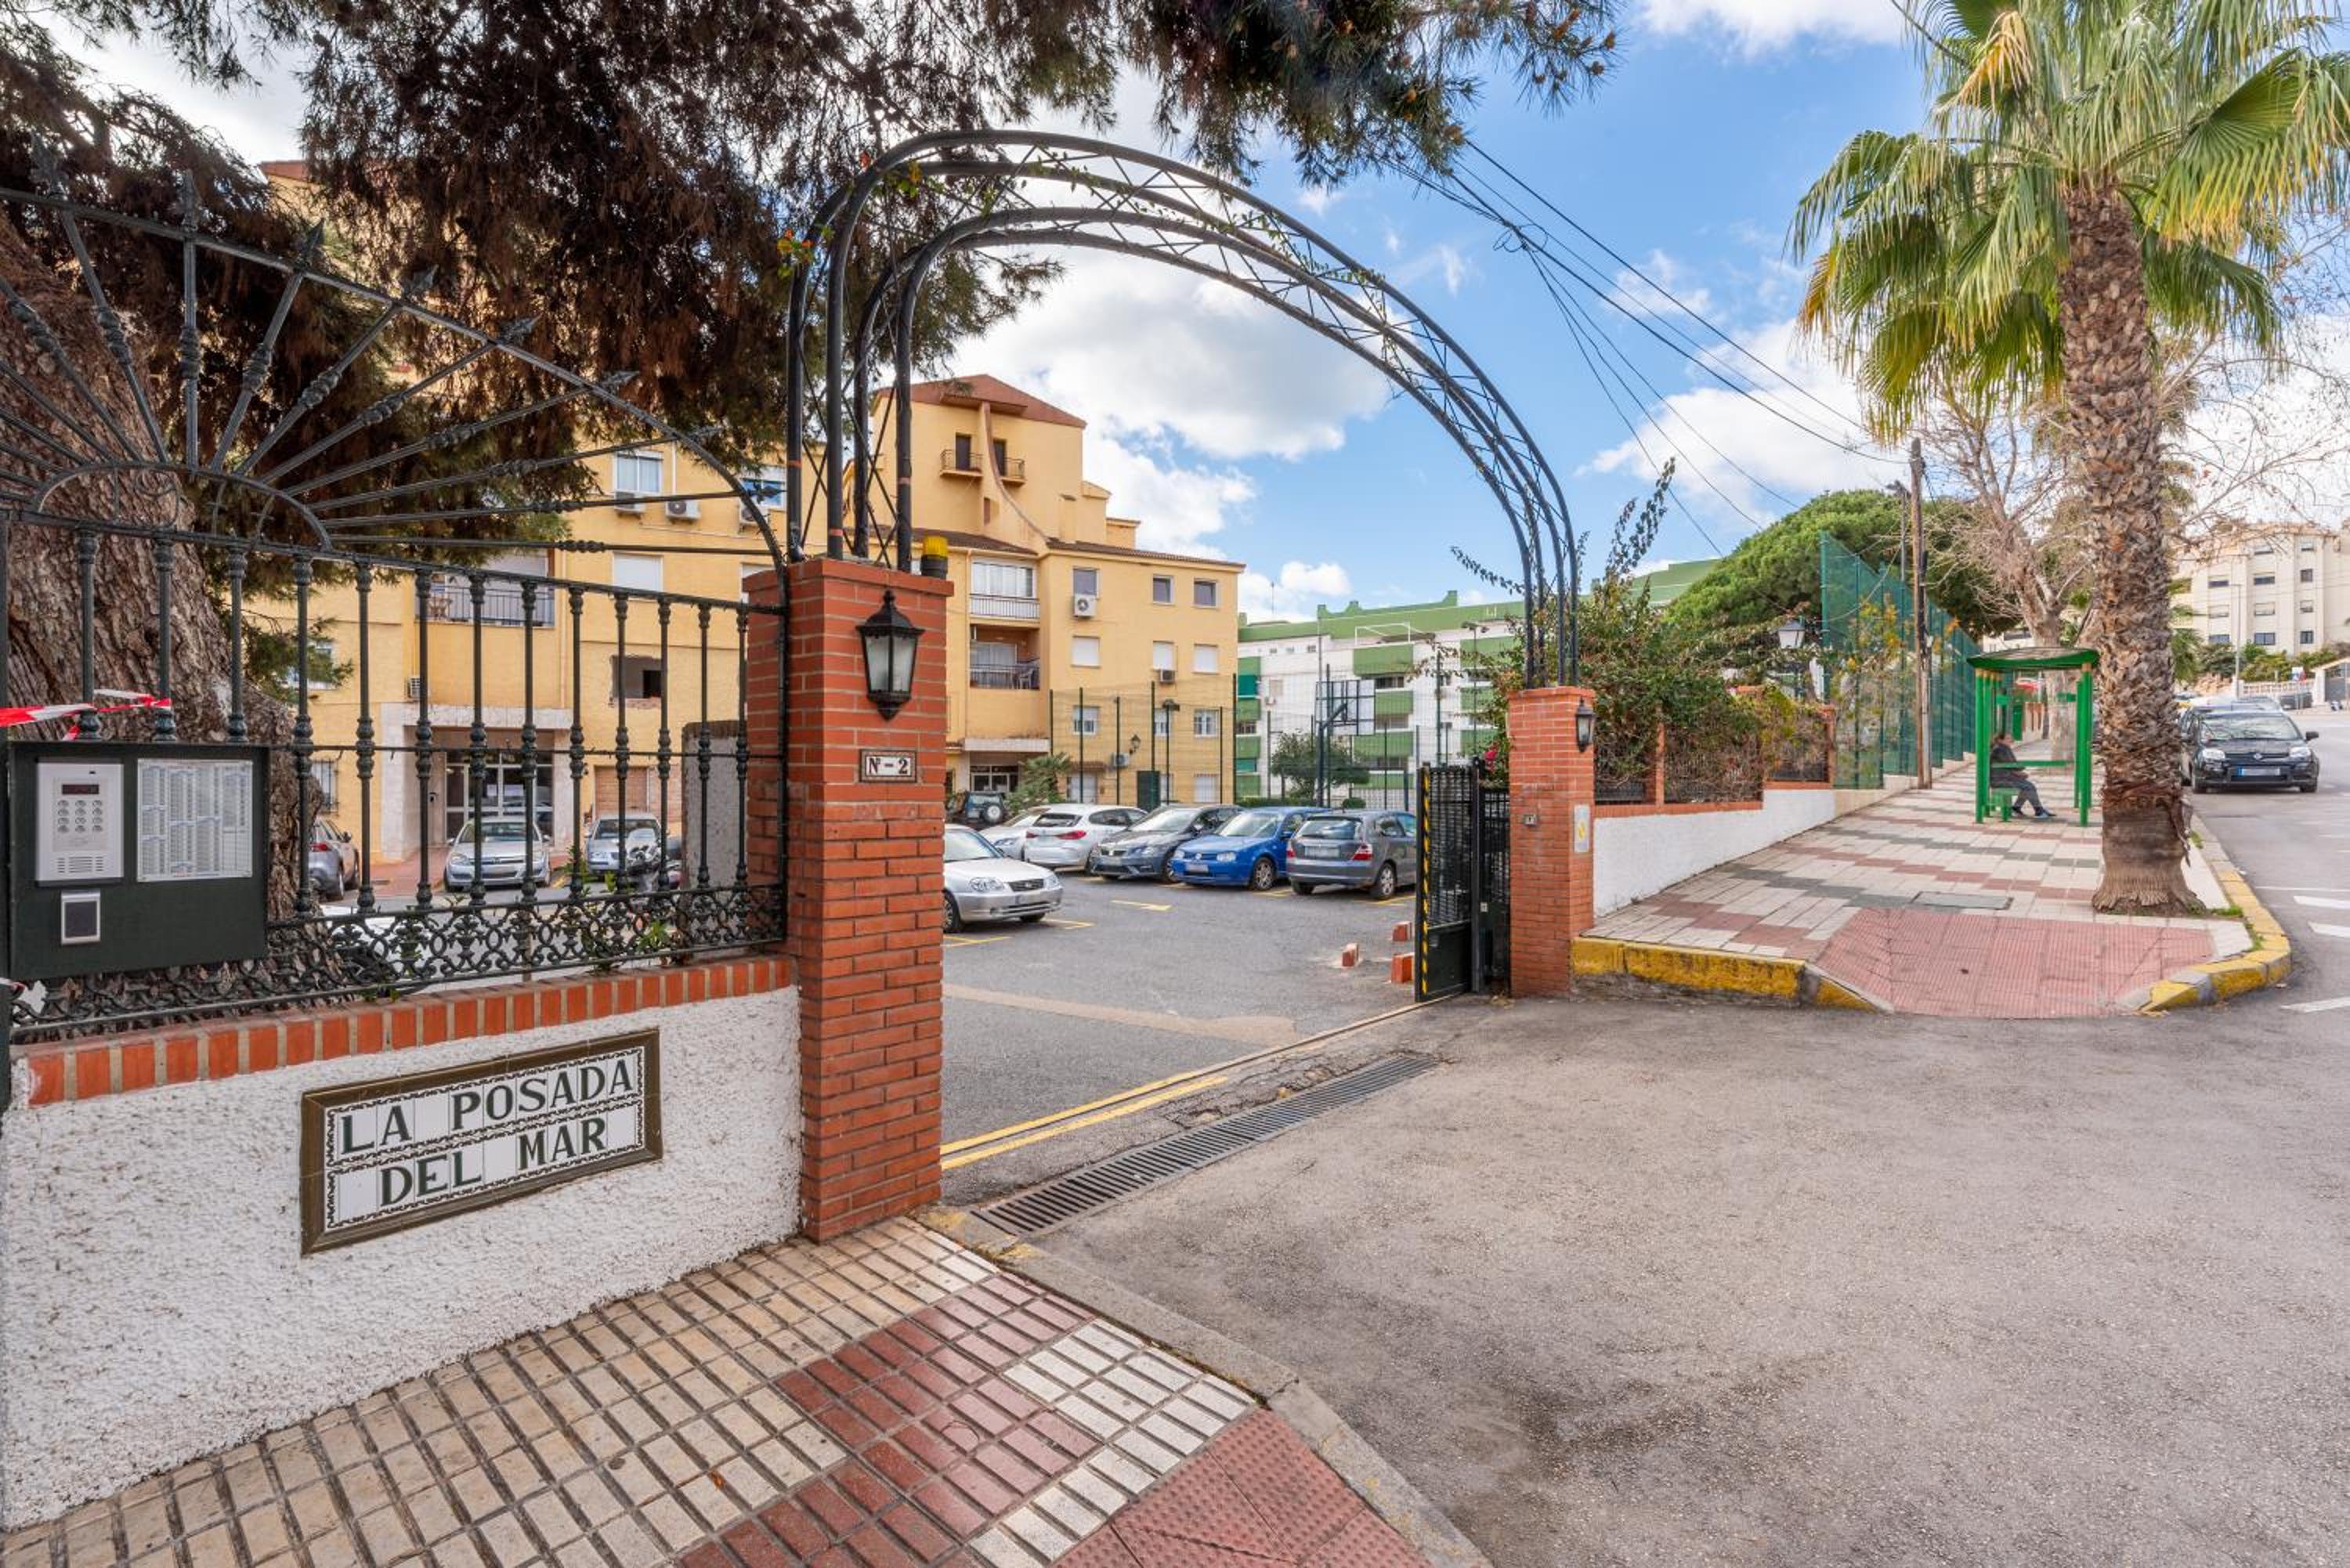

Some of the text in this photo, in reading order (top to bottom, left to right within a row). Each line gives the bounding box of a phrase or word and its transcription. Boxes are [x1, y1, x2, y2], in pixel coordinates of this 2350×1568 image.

[341, 1059, 633, 1154] LA POSADA
[380, 1118, 607, 1207] DEL MAR
